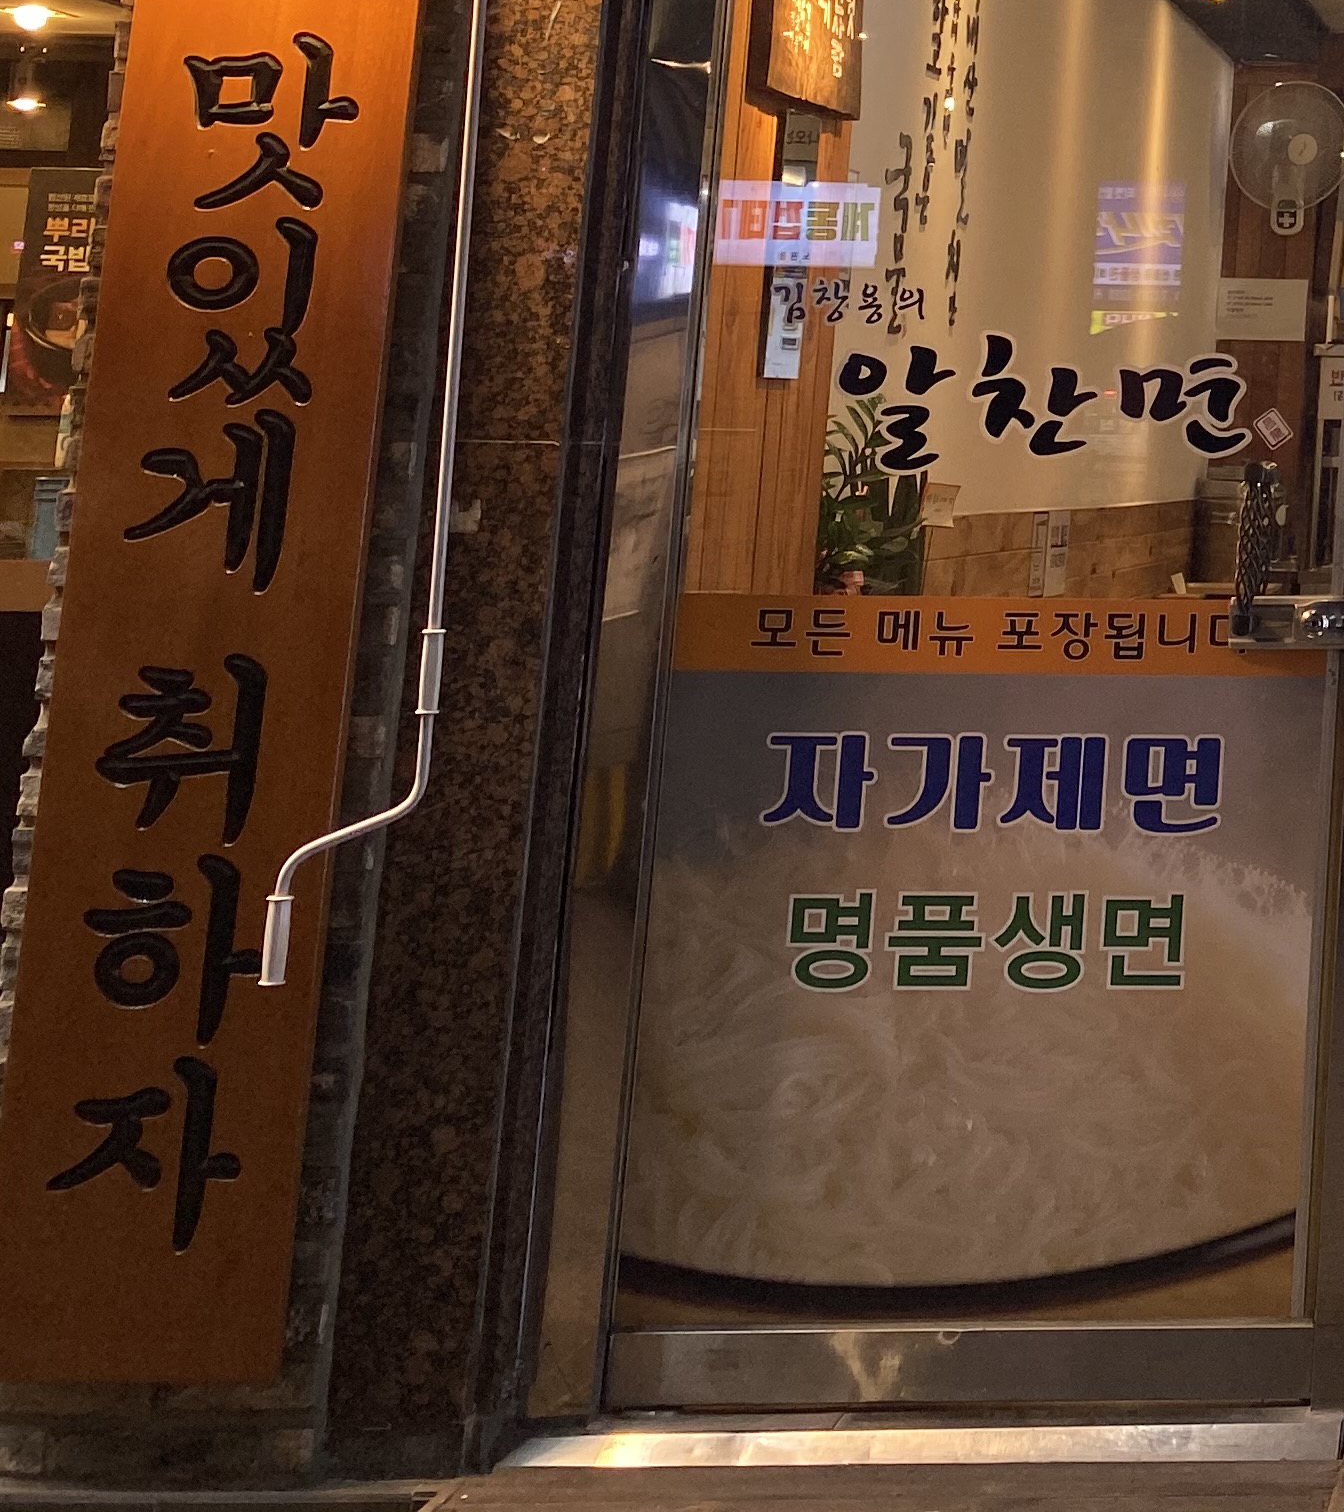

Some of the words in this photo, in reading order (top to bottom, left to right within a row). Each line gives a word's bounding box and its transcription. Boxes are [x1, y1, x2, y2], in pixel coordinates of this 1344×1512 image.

[124, 31, 360, 595] 맛있게
[750, 607, 853, 657] 모든
[876, 610, 976, 657] 메뉴
[760, 732, 1225, 835] 자가제면
[46, 653, 269, 1255] 취하자
[786, 890, 1187, 992] 명품생면
